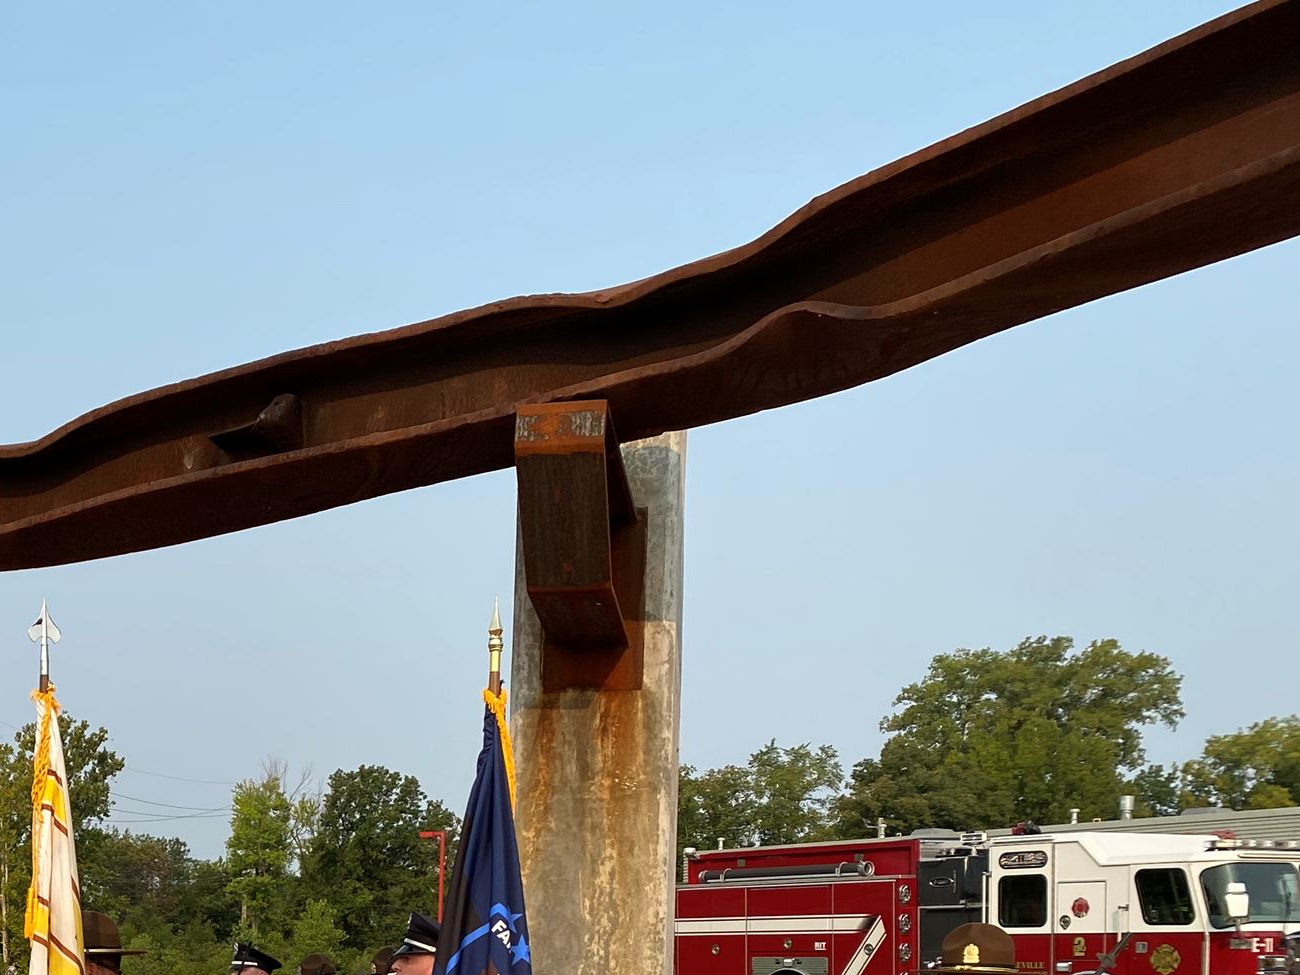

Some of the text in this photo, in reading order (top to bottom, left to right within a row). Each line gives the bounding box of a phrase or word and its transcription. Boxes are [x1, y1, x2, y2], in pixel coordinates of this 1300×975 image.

[491, 919, 512, 950] FA
[814, 941, 827, 951] RIT
[1073, 936, 1087, 957] 2
[1251, 937, 1274, 953] E-11
